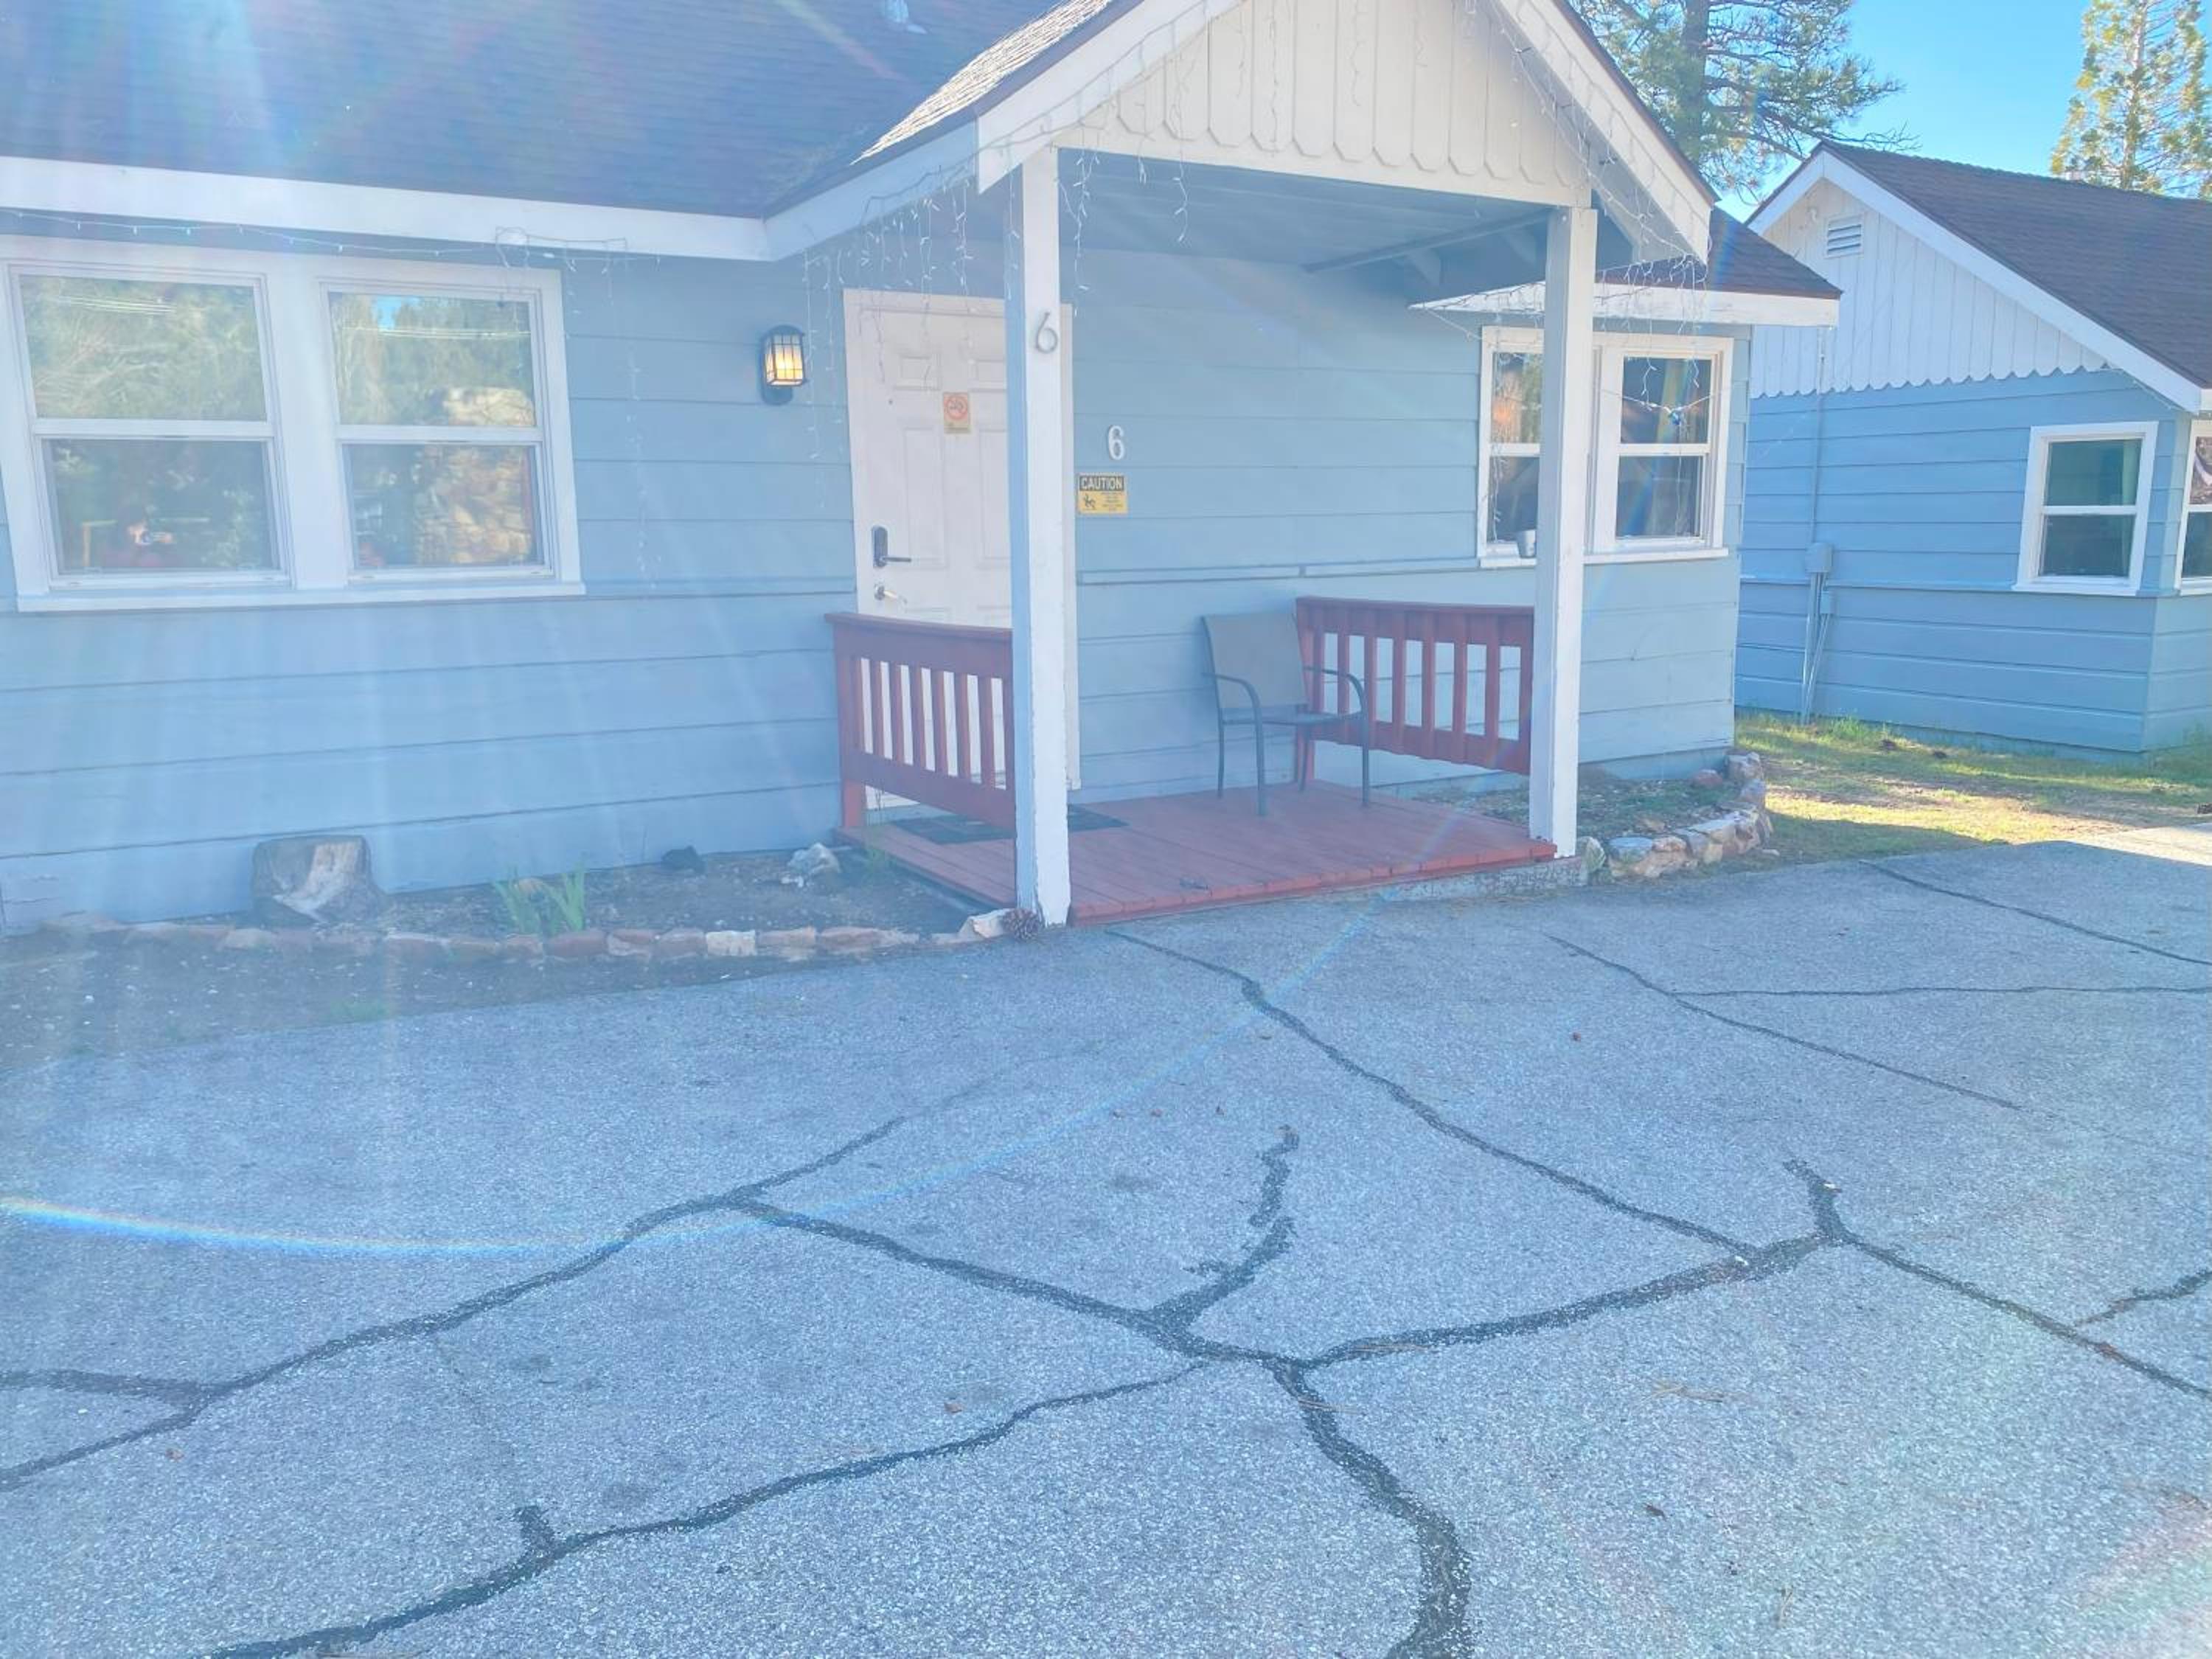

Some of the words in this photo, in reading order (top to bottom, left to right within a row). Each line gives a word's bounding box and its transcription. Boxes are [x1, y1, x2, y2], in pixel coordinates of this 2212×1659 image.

[1035, 311, 1058, 353] 6
[1108, 425, 1124, 459] 6
[1081, 476, 1122, 490] CAUTION
